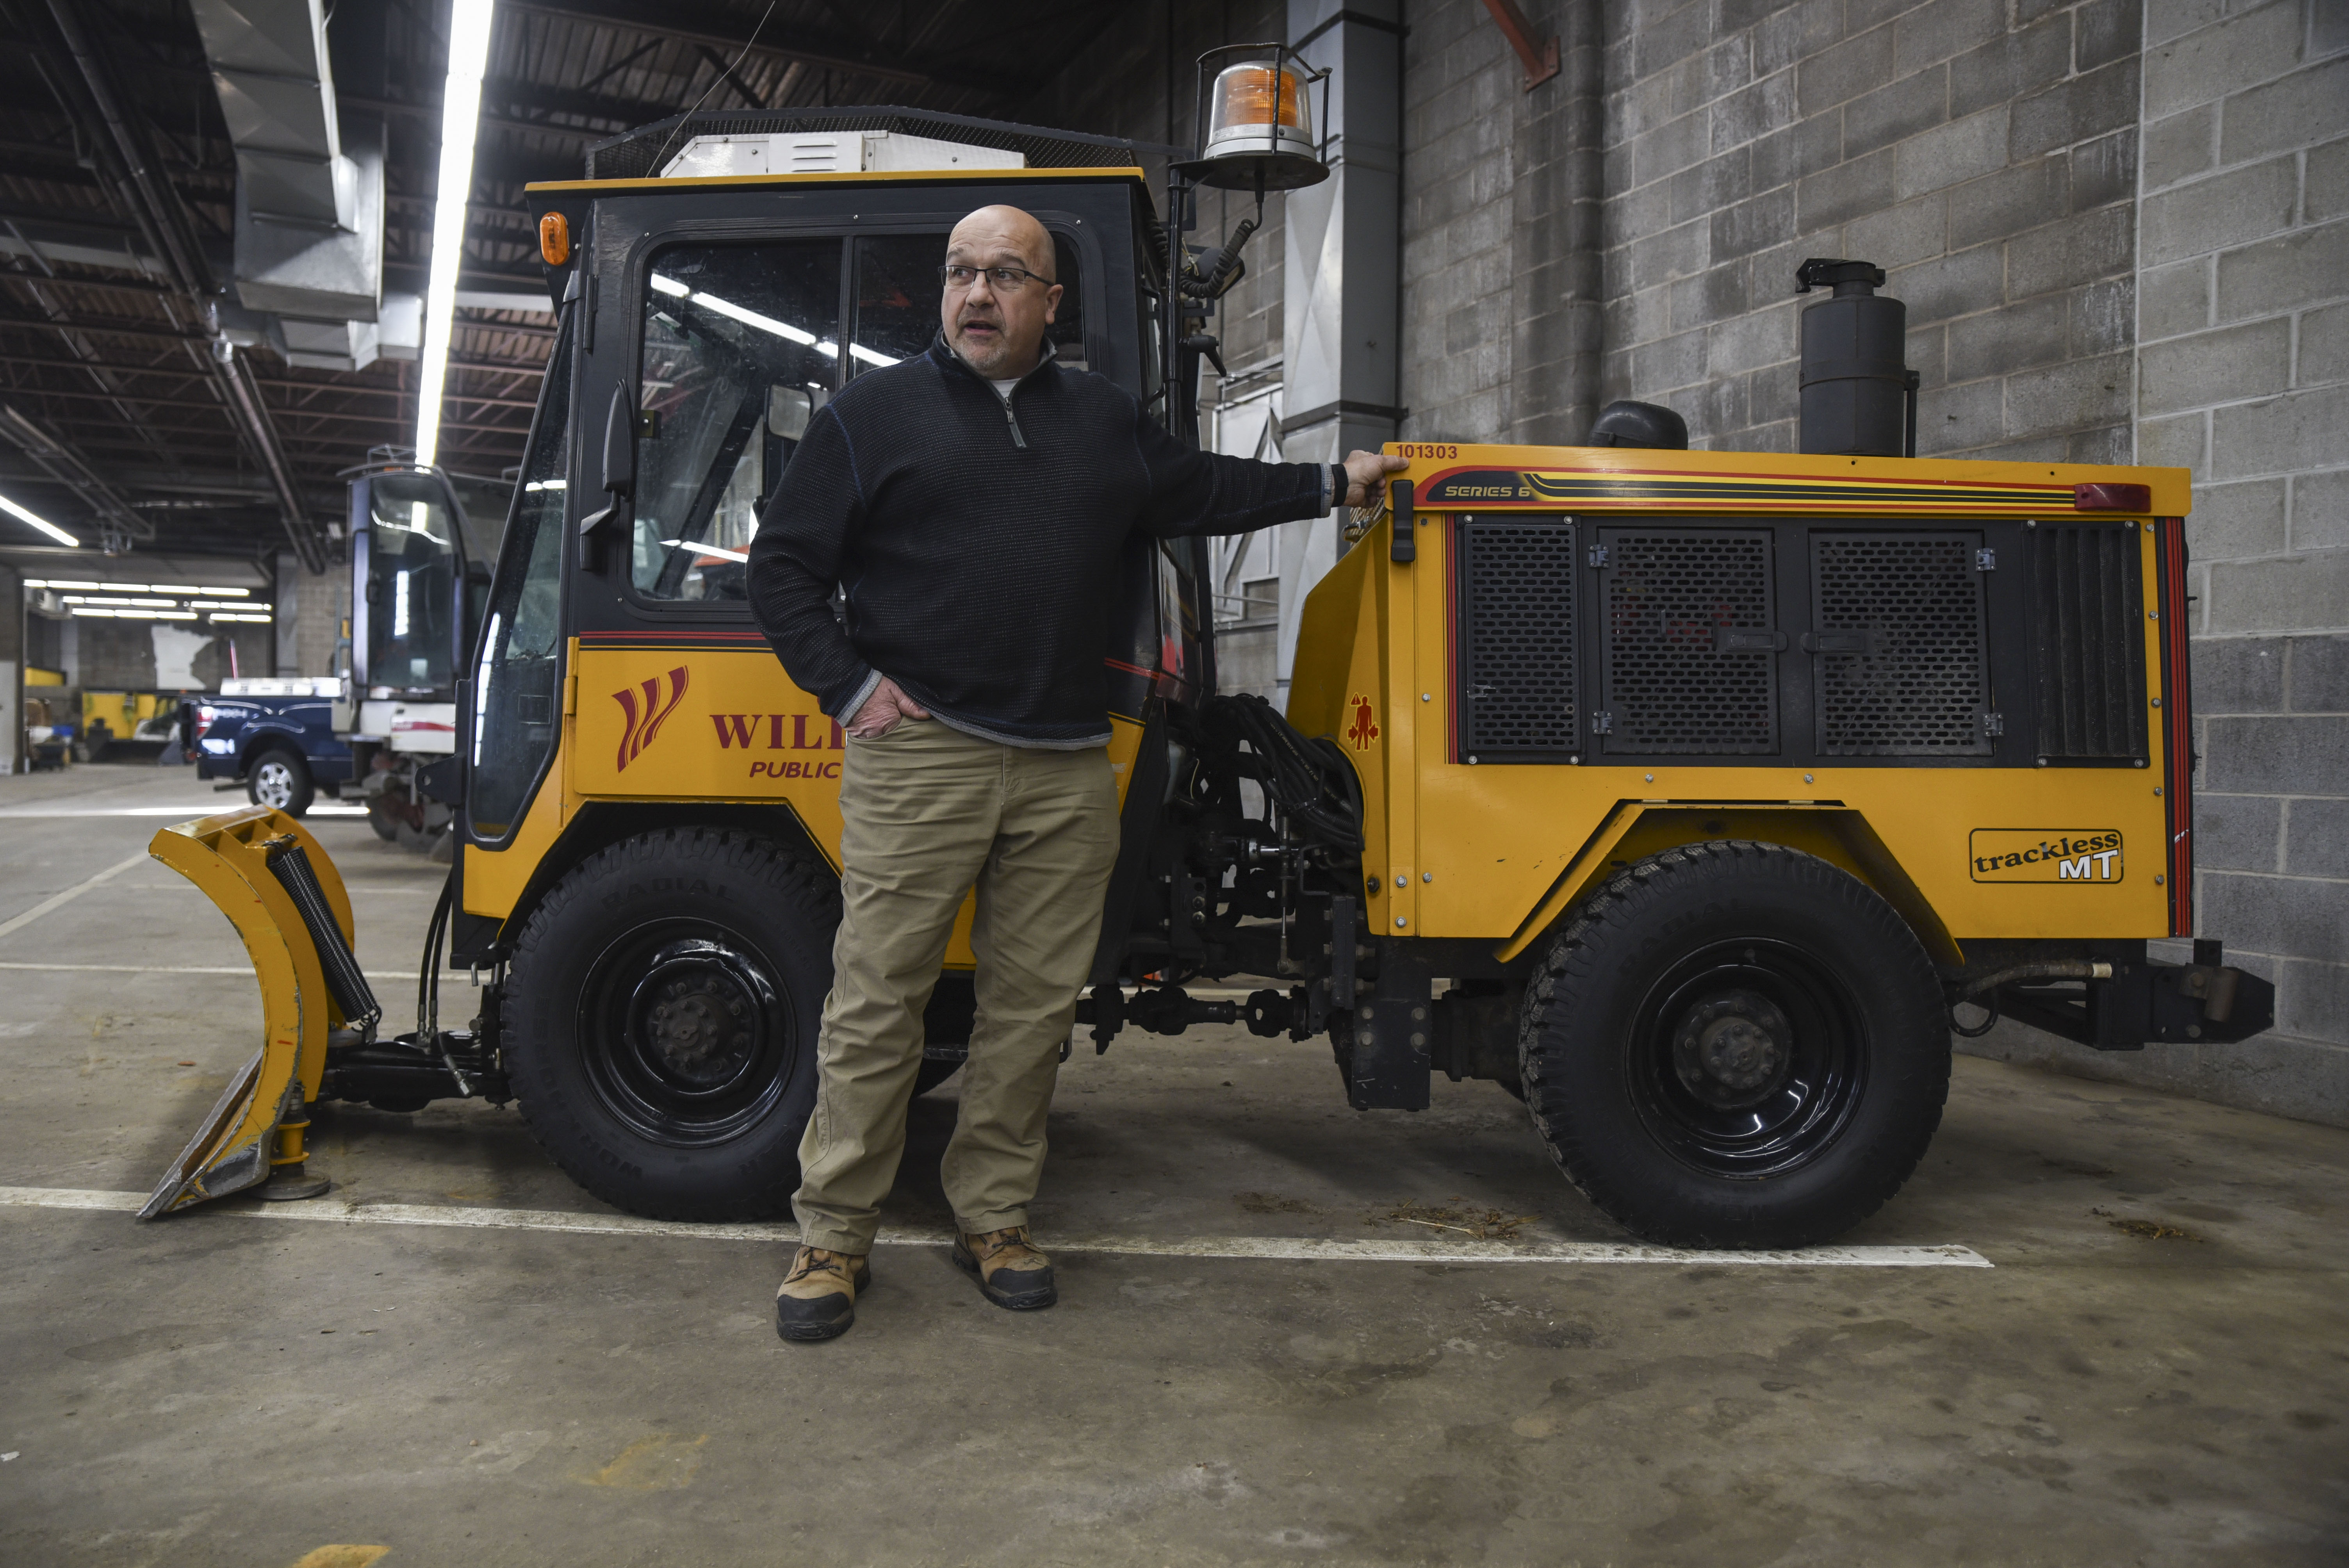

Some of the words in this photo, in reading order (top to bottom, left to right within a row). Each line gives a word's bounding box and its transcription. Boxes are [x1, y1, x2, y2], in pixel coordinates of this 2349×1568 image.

[1396, 444, 1457, 459] 101303
[1445, 486, 1512, 497] SERIES
[1518, 487, 1531, 497] 6
[749, 762, 841, 779] PUBLIC
[1974, 833, 2119, 872] trackless
[2059, 848, 2119, 879] MT
[601, 877, 736, 911] RADIAL
[1616, 898, 1751, 975] RADIAL
